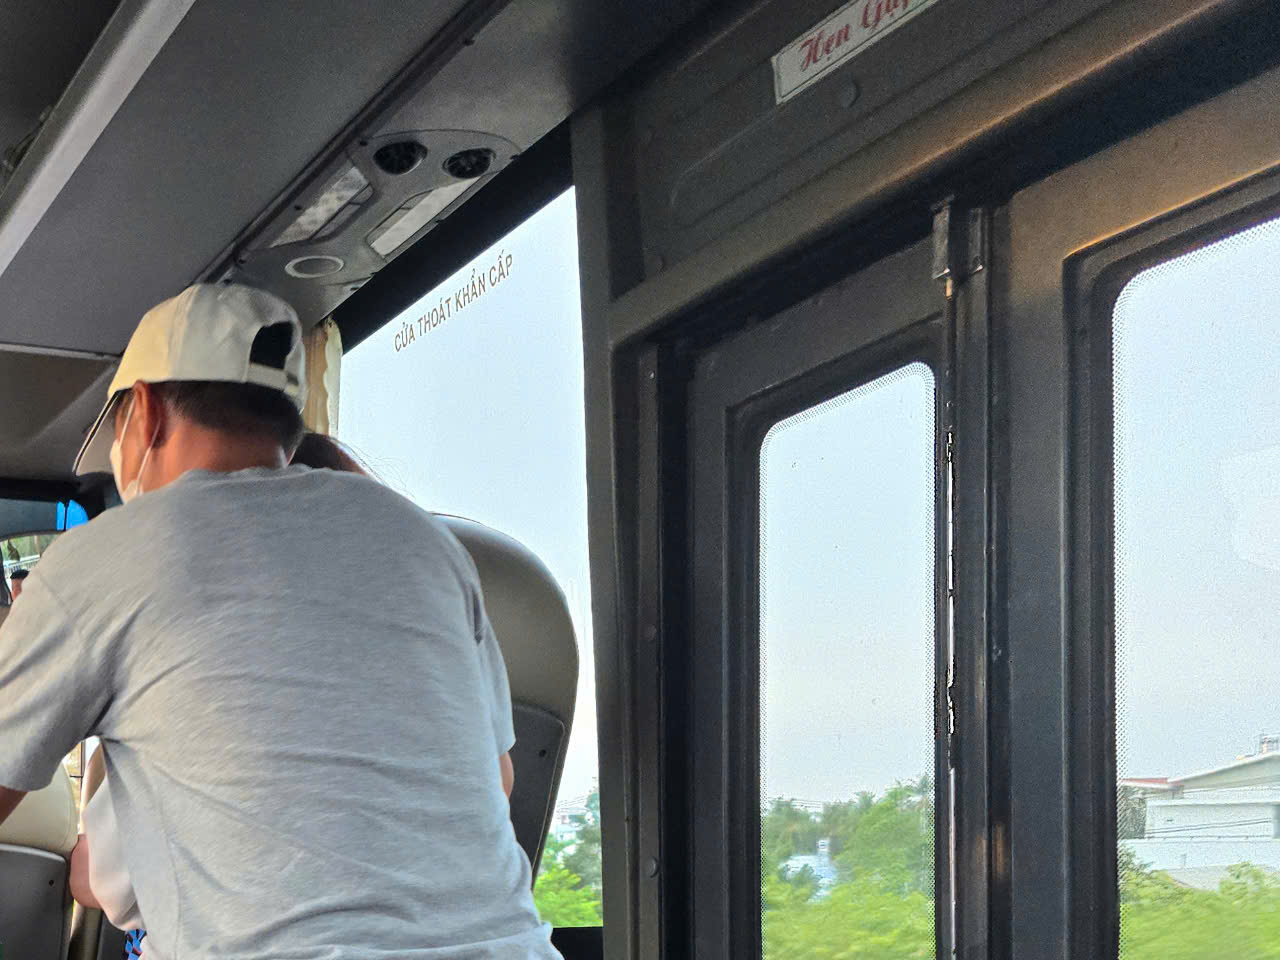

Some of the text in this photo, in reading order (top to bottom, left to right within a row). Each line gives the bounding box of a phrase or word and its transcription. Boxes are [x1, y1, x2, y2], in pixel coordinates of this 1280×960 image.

[800, 24, 850, 72] Hẹn
[394, 249, 513, 352] CỬA THOÁT KHẨN CẤP
